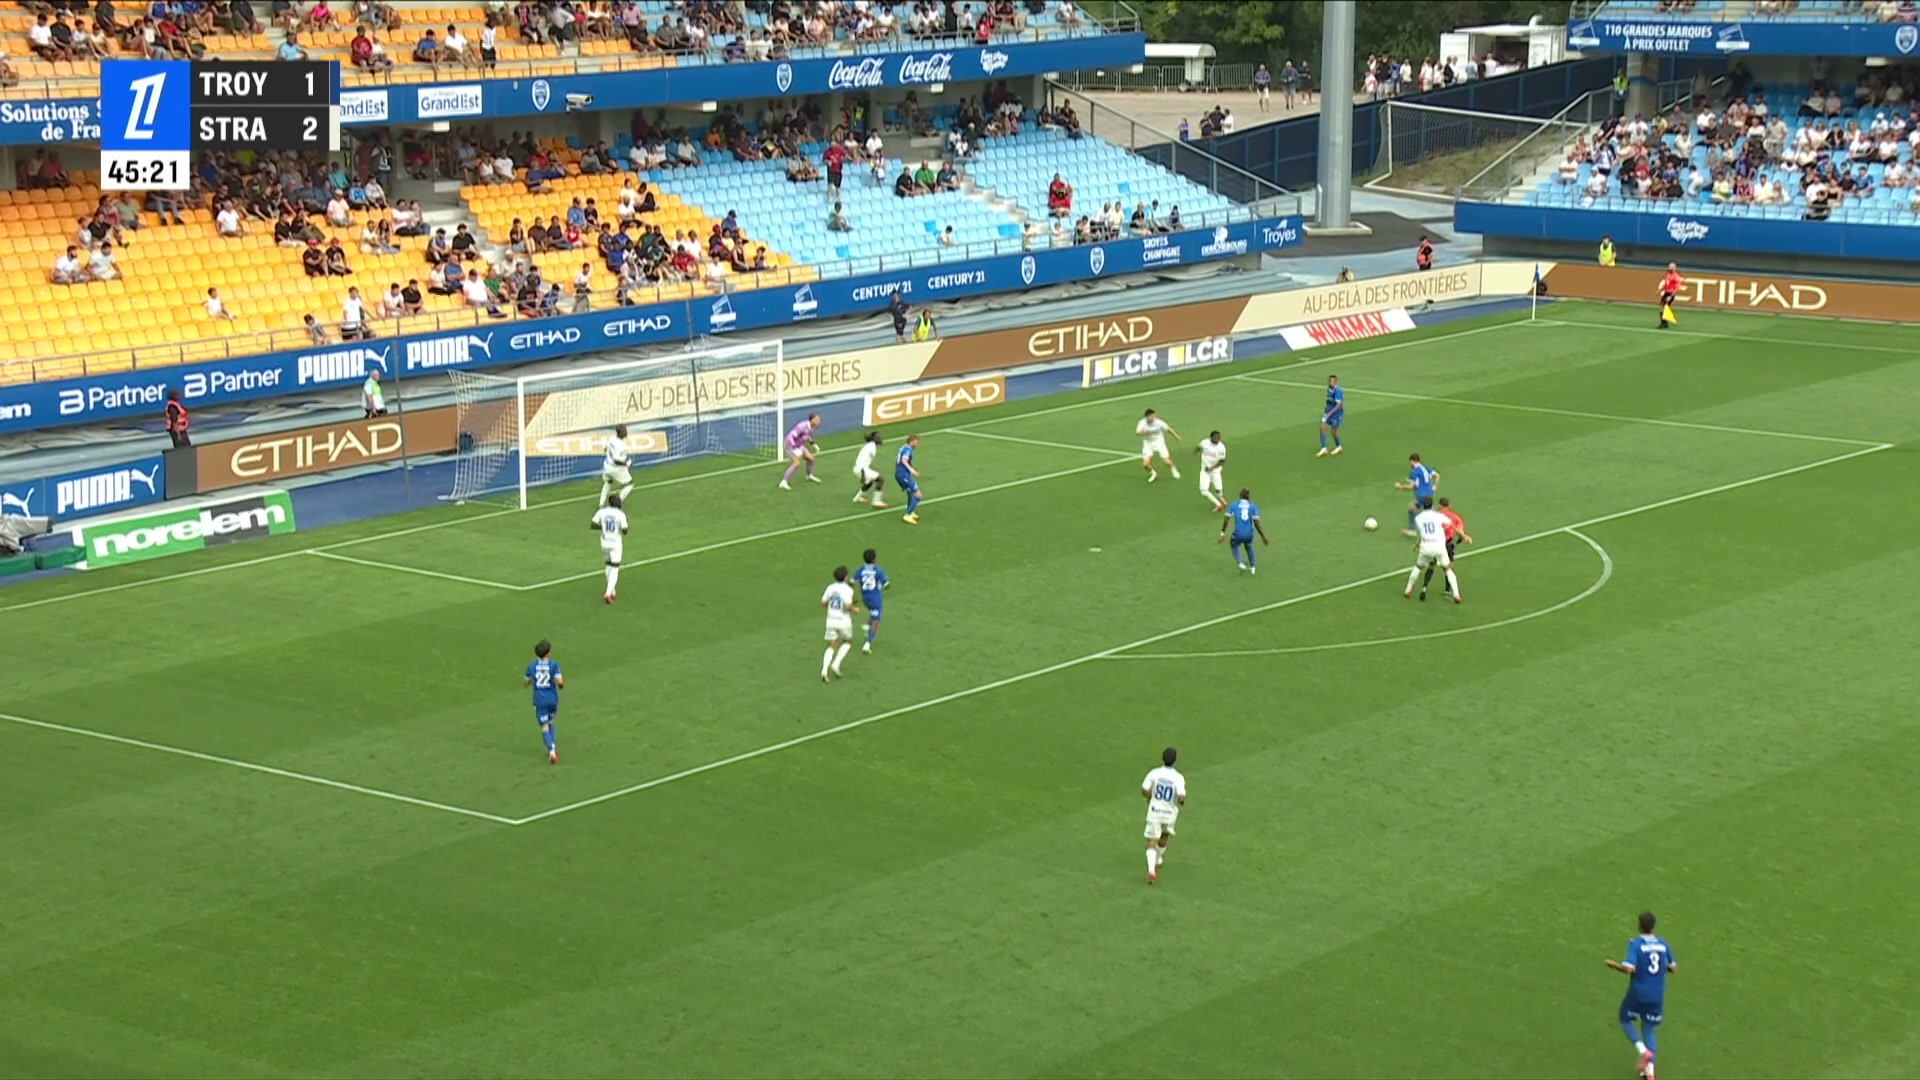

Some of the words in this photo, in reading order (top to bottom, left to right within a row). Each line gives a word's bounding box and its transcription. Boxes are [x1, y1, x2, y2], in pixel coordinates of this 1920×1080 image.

[1604, 24, 1621, 36] 110
[1622, 24, 1666, 37] GRANDES
[1666, 25, 1713, 39] MARQUES
[1632, 38, 1655, 50] PRIX
[1655, 39, 1691, 51] OUTLET
[1, 101, 89, 123] Solutions
[41, 122, 64, 140] de
[1263, 226, 1297, 248] Troyes
[853, 281, 900, 301] CENTURY
[902, 280, 912, 294] 21
[928, 272, 975, 290] CENTURY
[976, 270, 985, 284] 21
[1303, 285, 1361, 314] AU-DELÀ
[1365, 283, 1389, 305] DES
[1393, 272, 1468, 299] FRONTIÈRES
[510, 327, 581, 351] ETIHAD
[604, 315, 671, 337] ETIHAD
[1028, 316, 1153, 357] ETIHAD
[1304, 311, 1392, 346] WINAMAX
[407, 335, 469, 370] PUMA
[1112, 350, 1158, 376] LCR
[1185, 337, 1229, 364] LCR
[298, 348, 365, 386] PUMA
[211, 368, 283, 394] Partner
[625, 376, 709, 413] AU-DELÀ
[715, 375, 749, 400] DES
[88, 383, 167, 410] Partner
[876, 382, 1000, 419] ETIHAD
[231, 422, 402, 477] ETIHAD
[57, 470, 131, 515] PUMA
[93, 503, 286, 557] norelem
[1423, 521, 1435, 534] 10
[535, 671, 551, 688] 22
[1155, 784, 1173, 802] 80
[1648, 952, 1660, 974] 3
